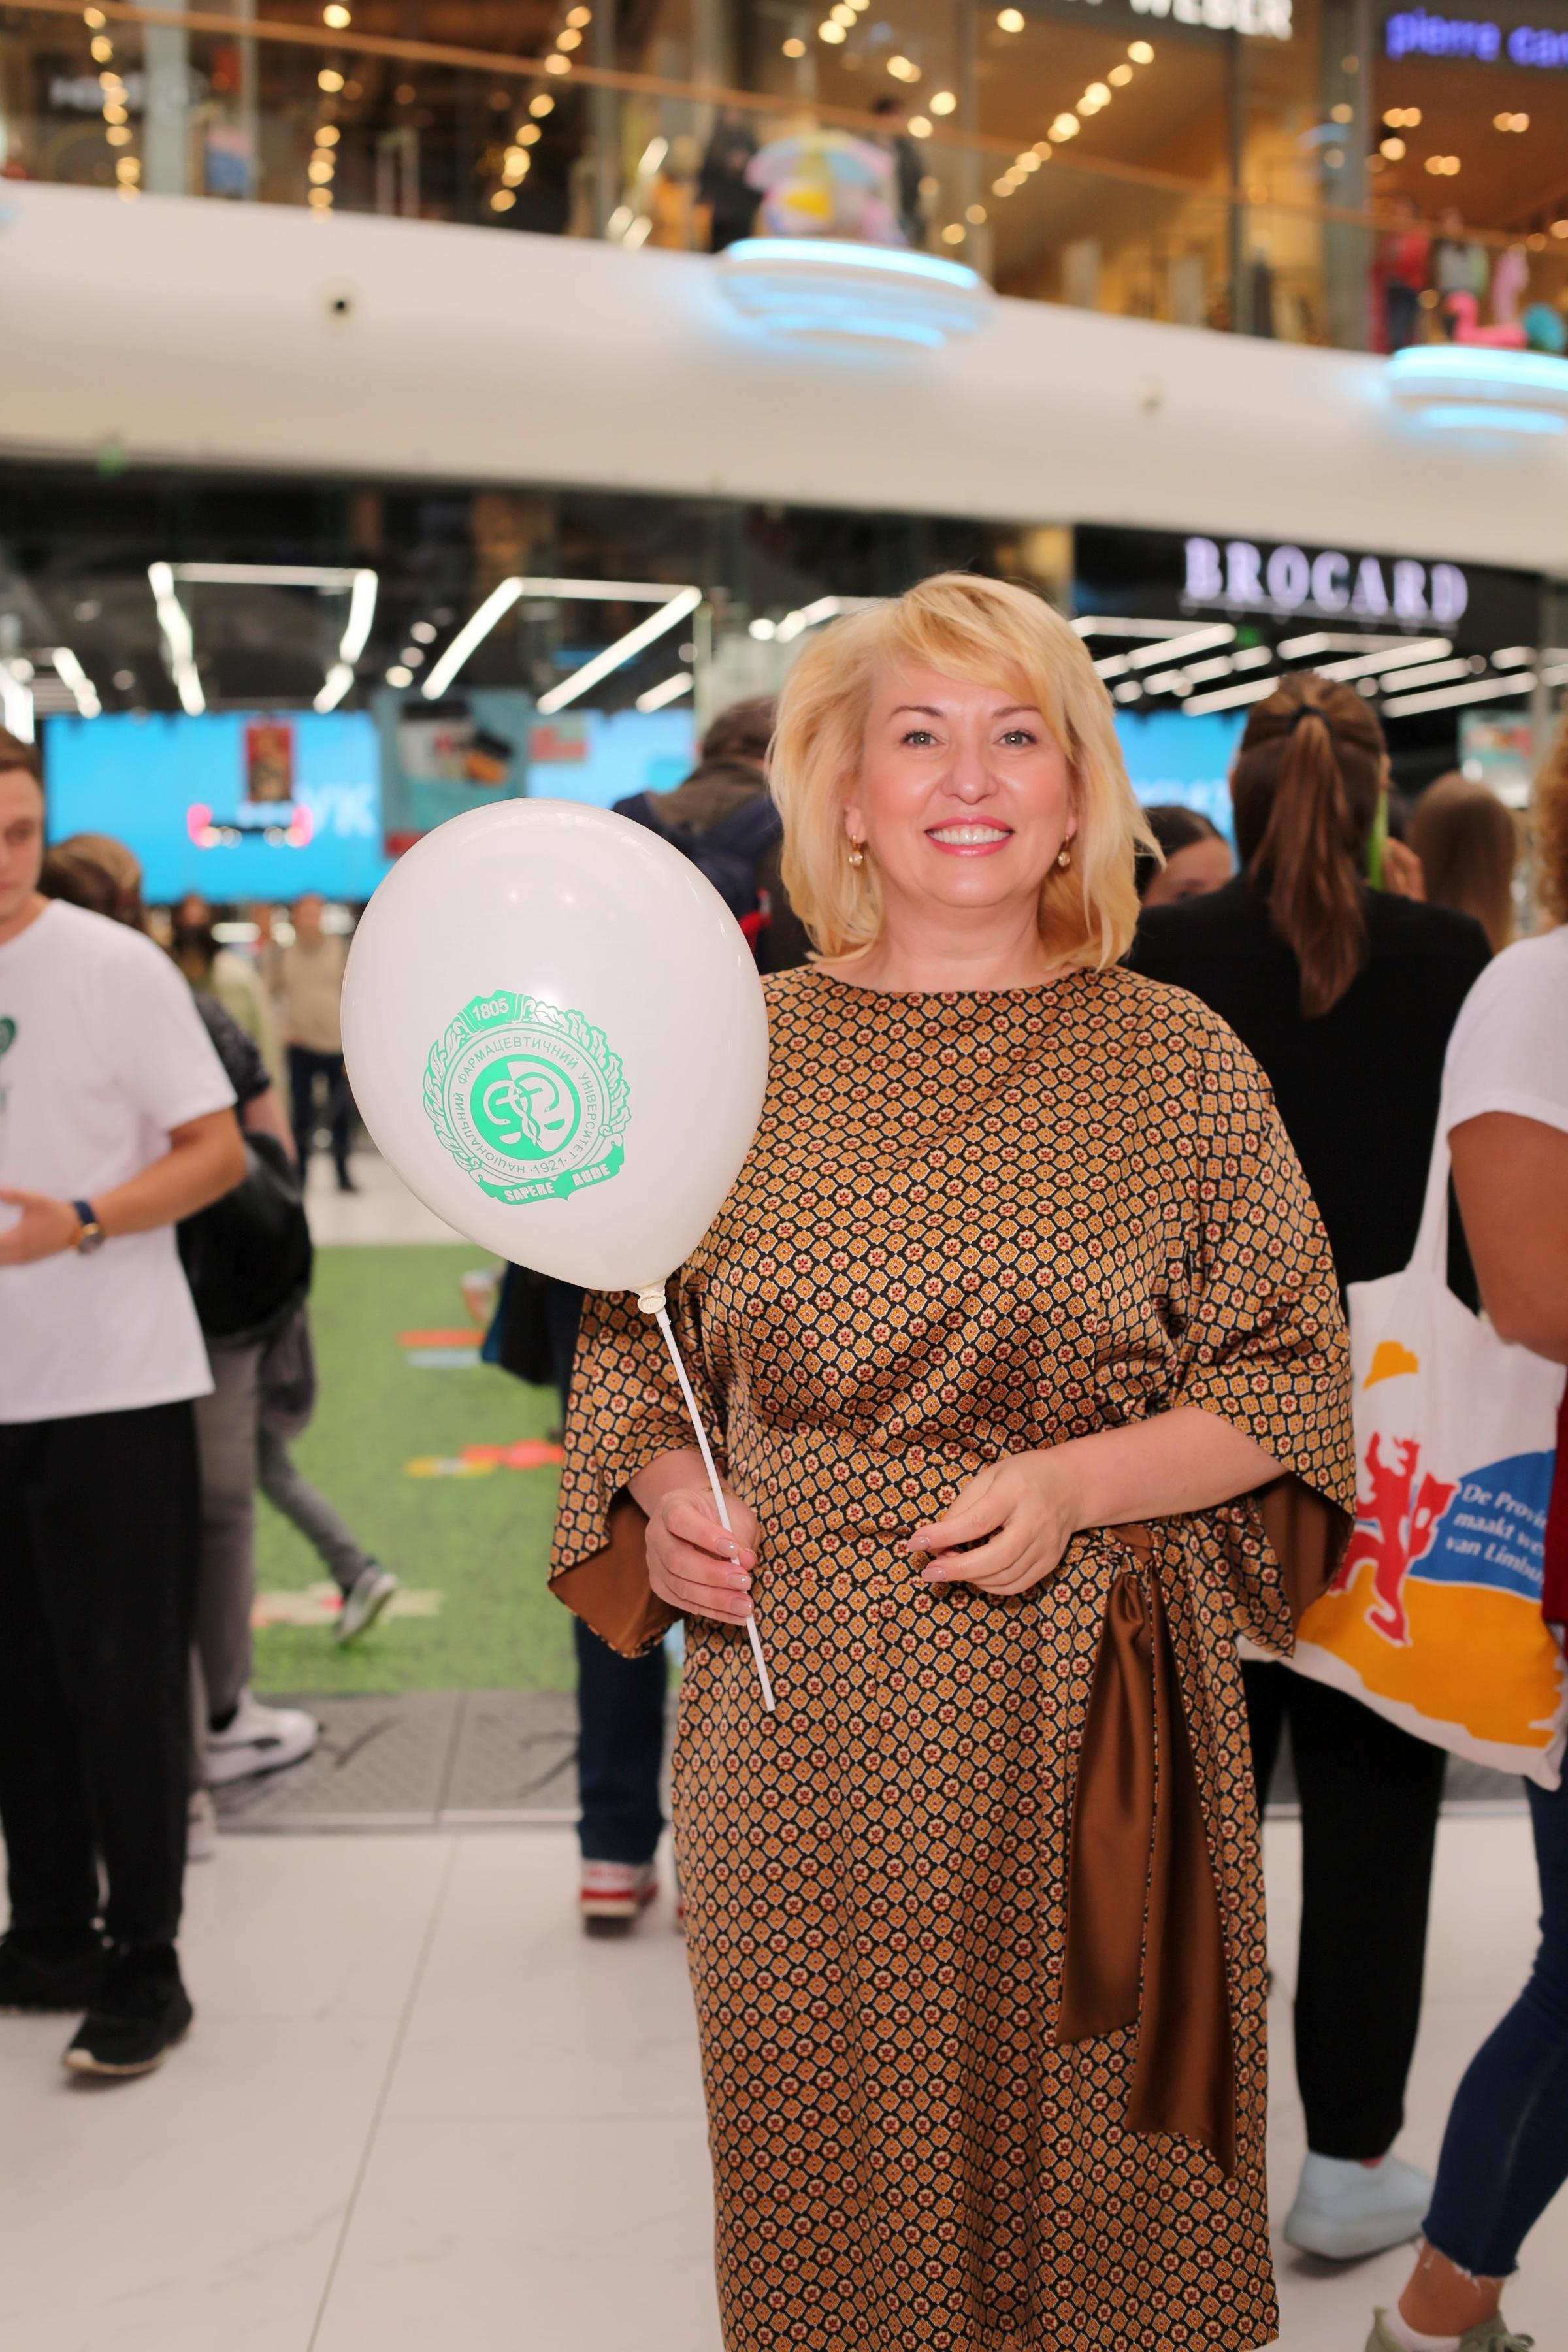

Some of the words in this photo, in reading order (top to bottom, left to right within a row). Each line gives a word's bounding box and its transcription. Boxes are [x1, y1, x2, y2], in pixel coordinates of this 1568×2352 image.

[1386, 7, 1500, 61] pierre
[1184, 536, 1469, 623] BROCARD
[471, 997, 510, 1022] 1805
[457, 1036, 580, 1085] ФАРМАЦЕВТИЧНИЙ
[452, 1092, 525, 1173] НАЦІОНАЛЬНИЙ
[569, 1071, 597, 1159] УНІВЕРСИТЕТ
[503, 1181, 555, 1202] SAPERE
[571, 1163, 611, 1186] AUDE
[1462, 1483, 1492, 1506] De
[1445, 1535, 1482, 1556] van
[1452, 1512, 1515, 1541] maakt
